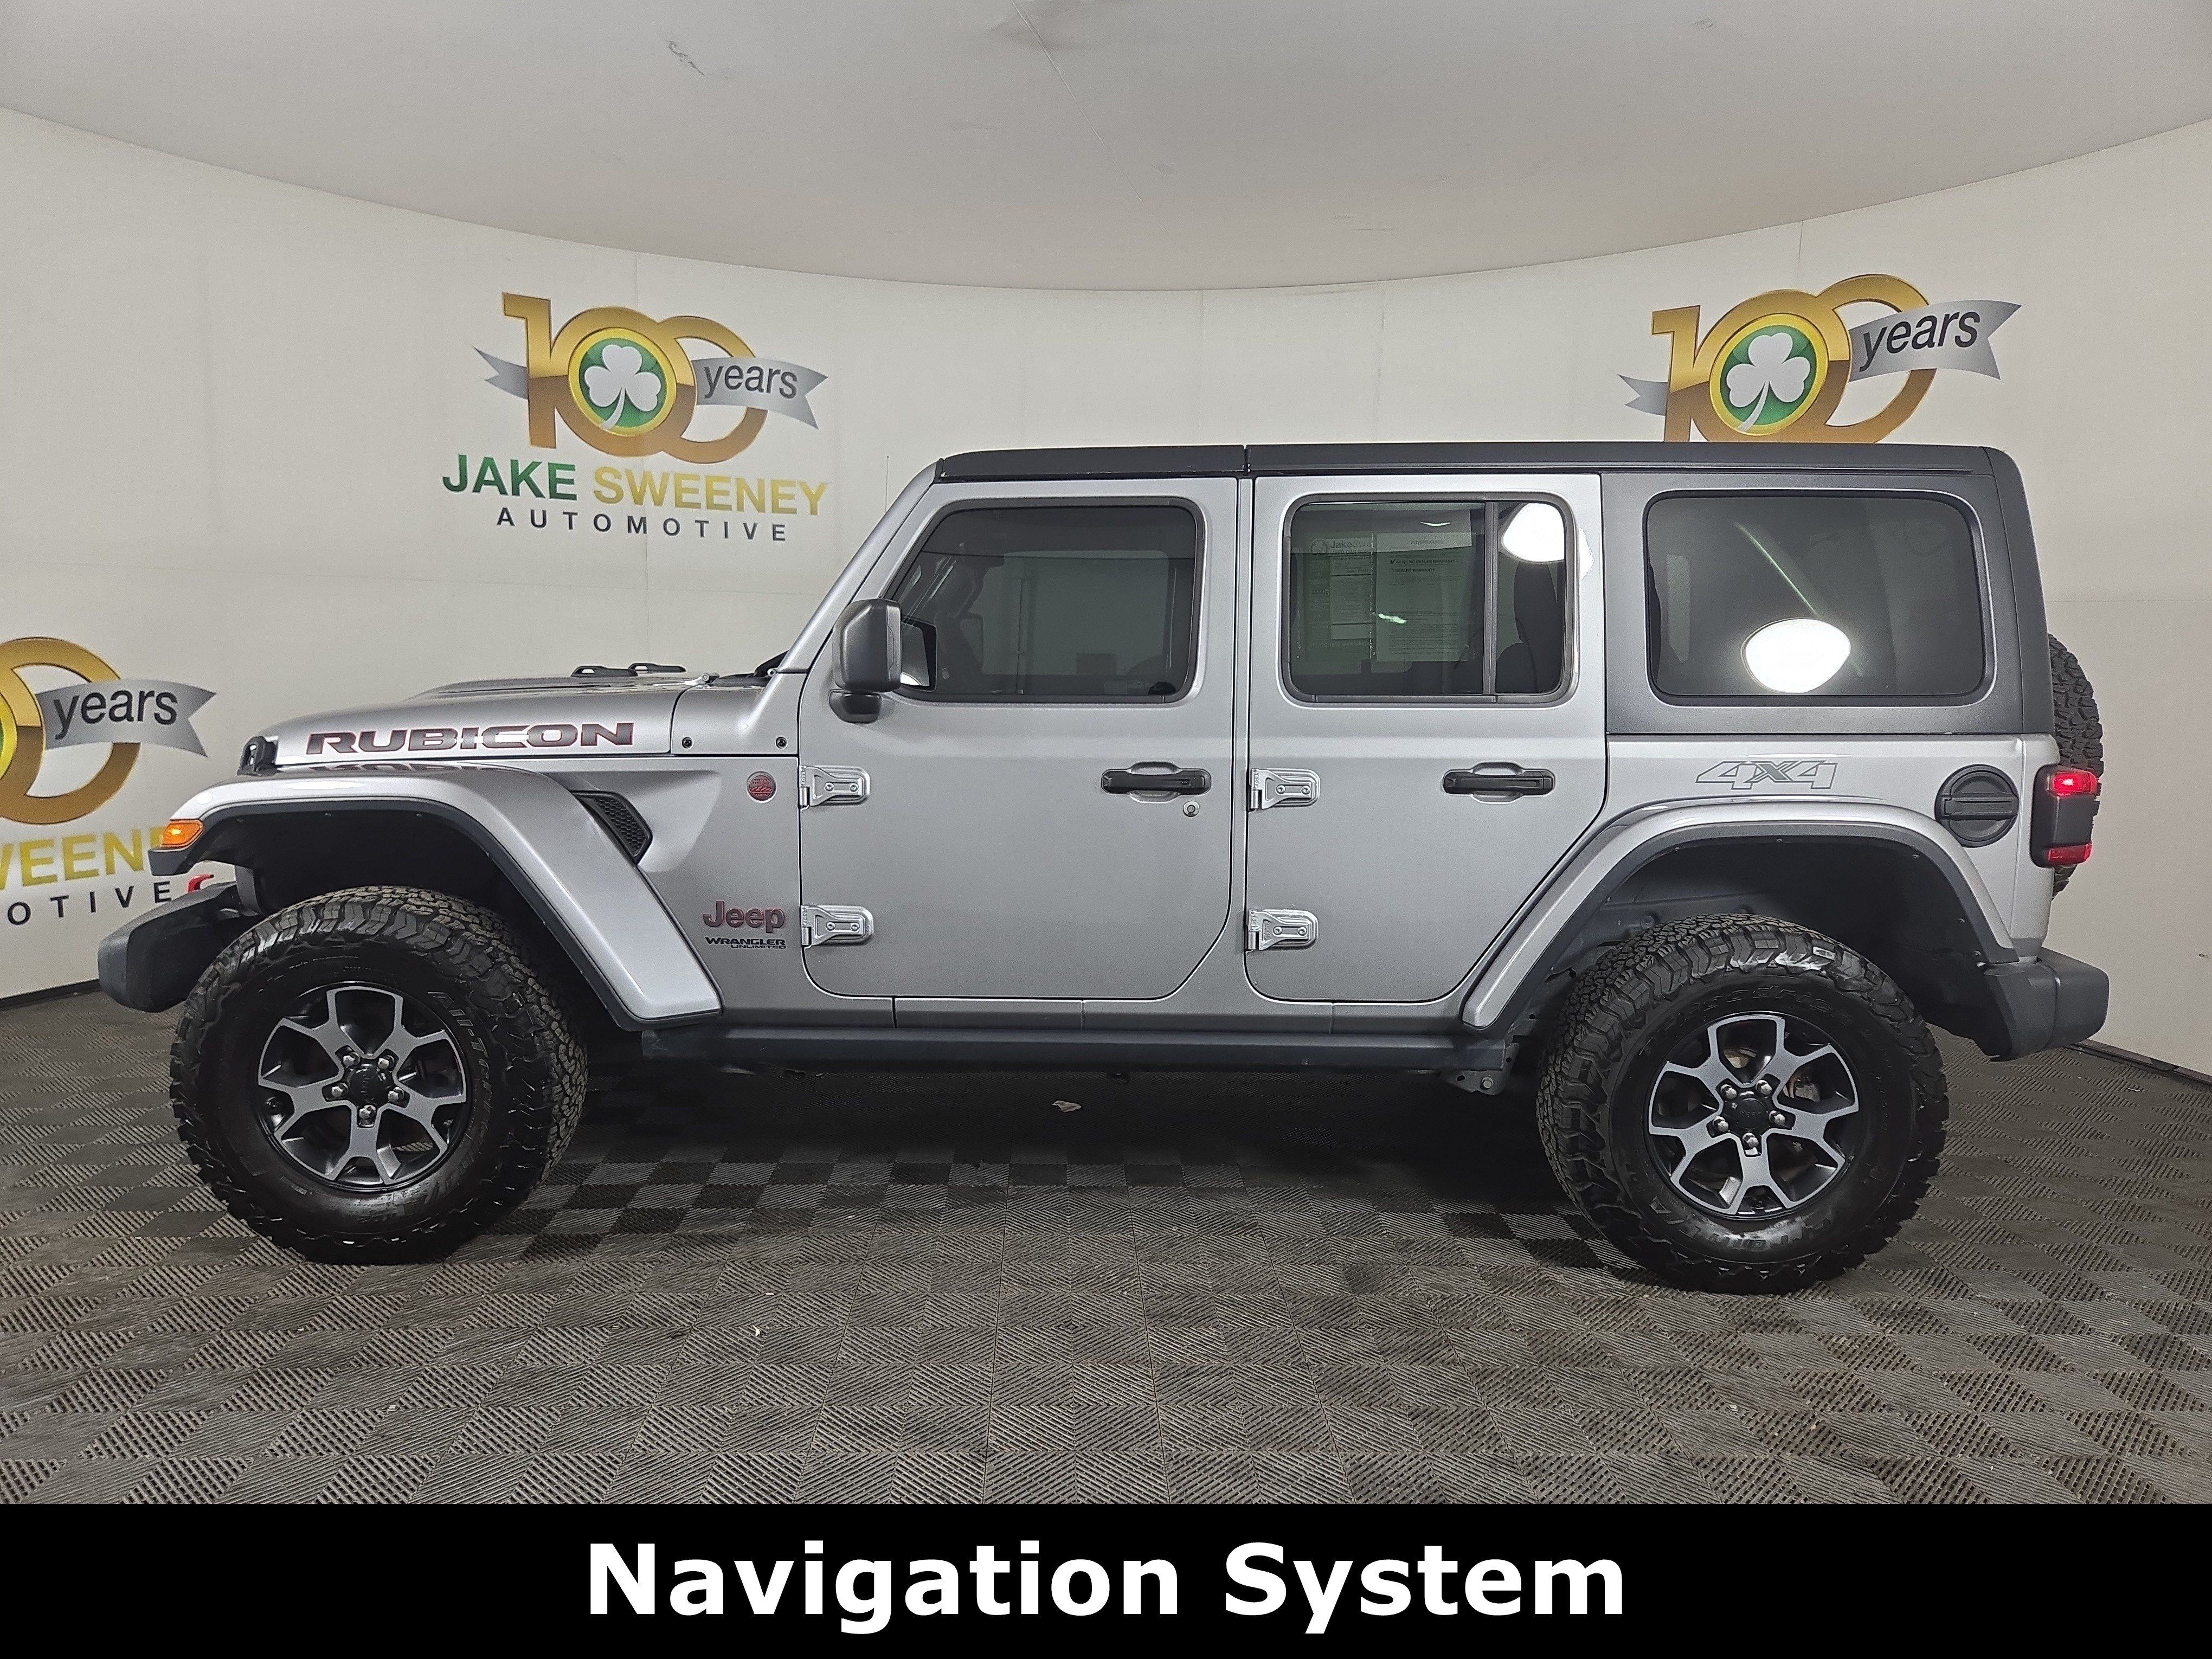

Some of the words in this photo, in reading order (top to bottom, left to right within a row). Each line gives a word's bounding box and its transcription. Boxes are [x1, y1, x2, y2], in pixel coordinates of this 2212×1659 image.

[1860, 311, 1981, 372] years
[704, 364, 799, 400] years
[442, 454, 578, 501] JAKE
[593, 466, 830, 516] SWEENEY
[497, 507, 787, 542] AUTOMOTIVE
[53, 690, 178, 740] years
[305, 722, 634, 755] RUBICON
[703, 901, 786, 934] Jeep
[705, 936, 786, 946] WRANGLER
